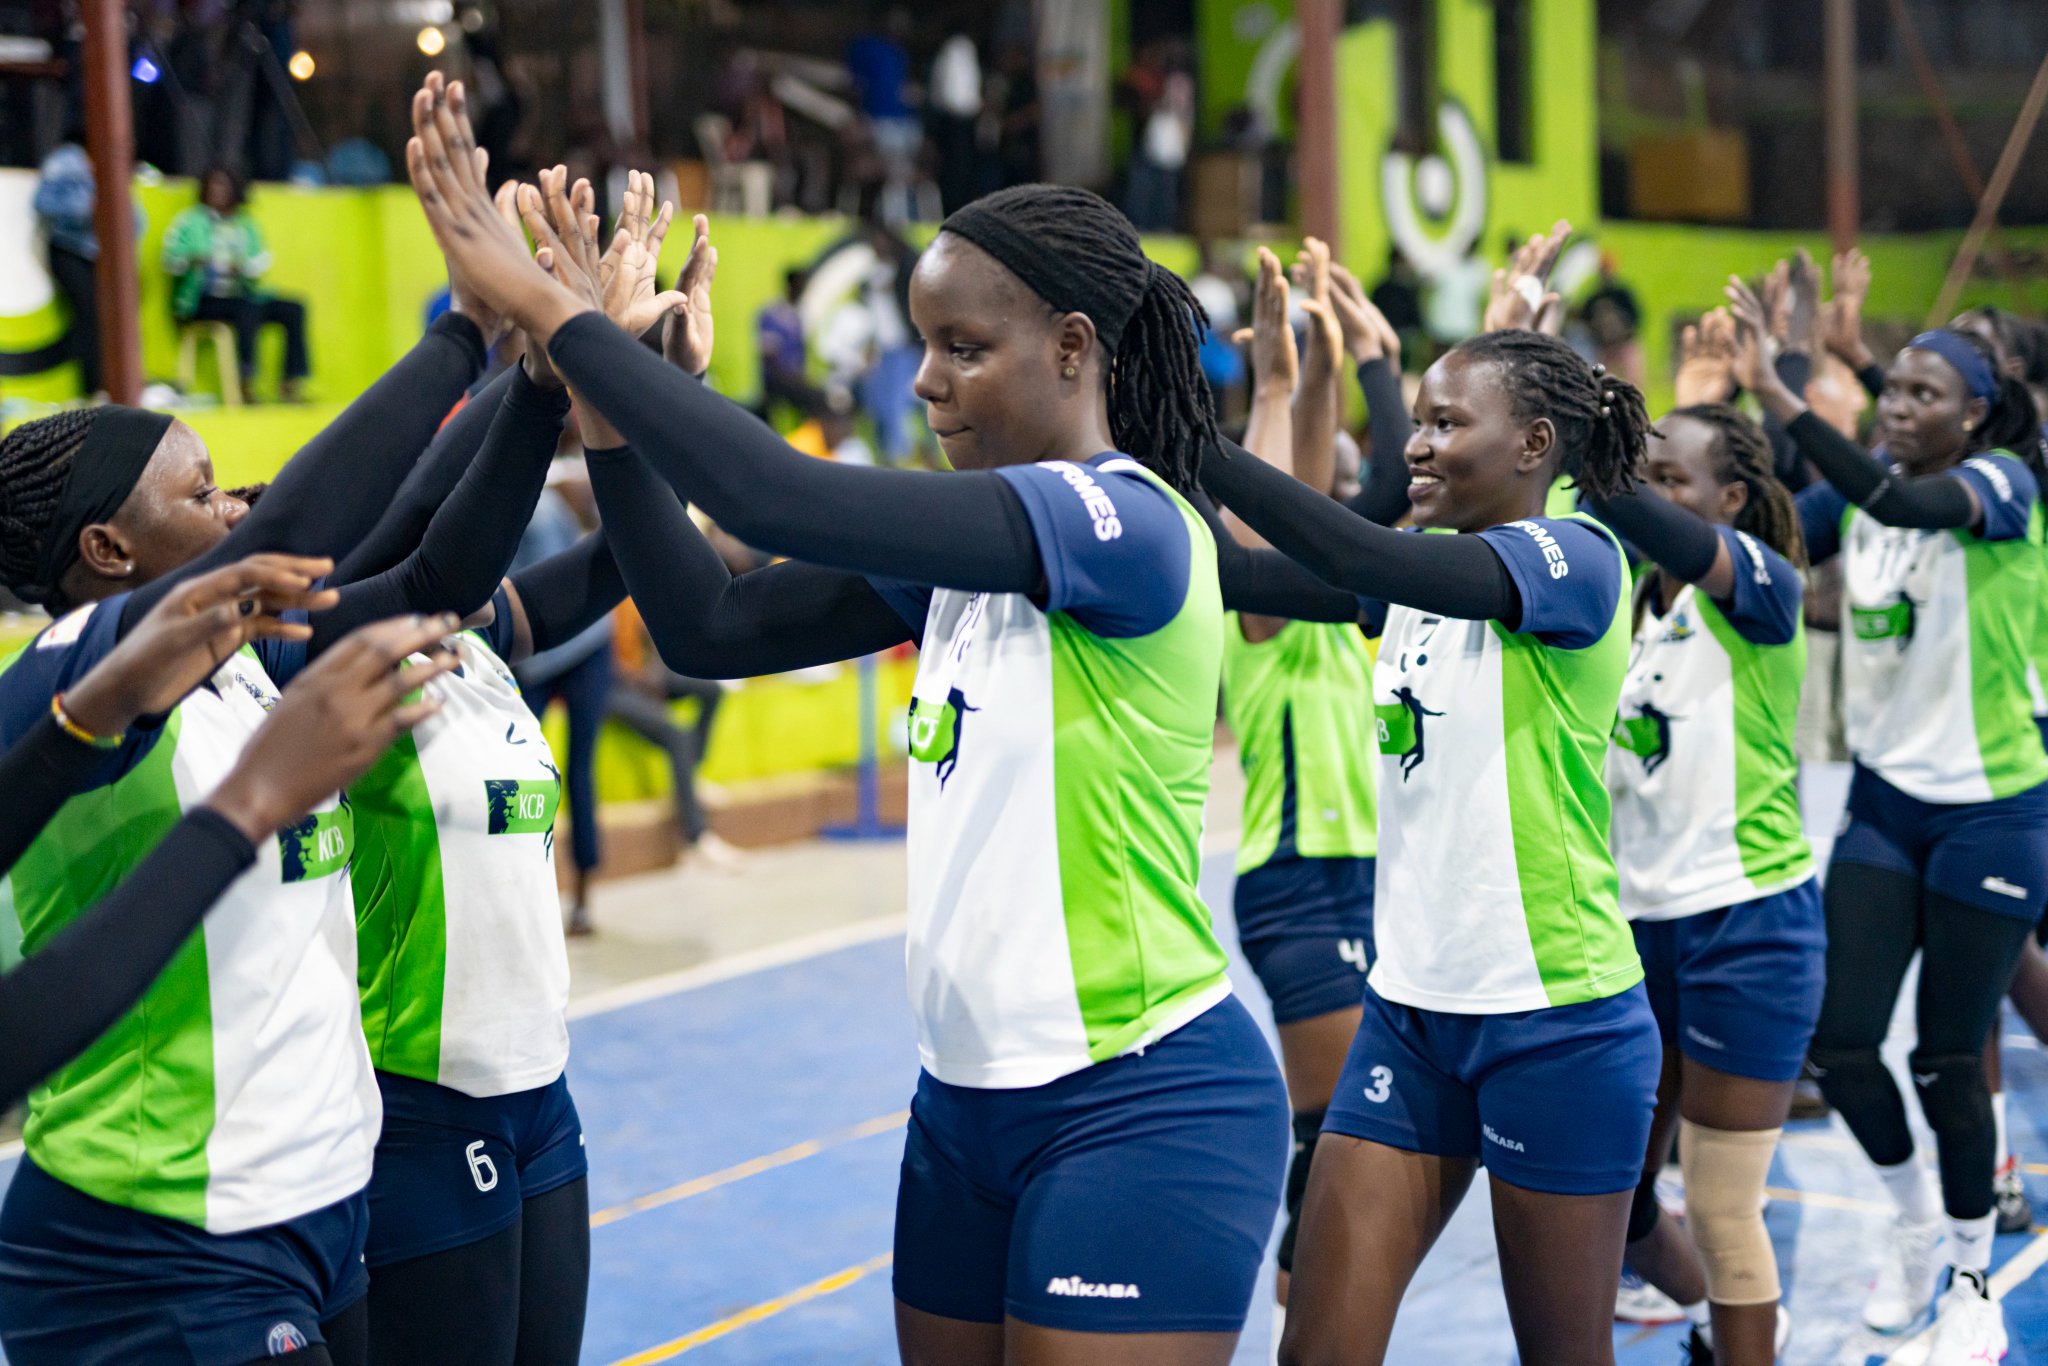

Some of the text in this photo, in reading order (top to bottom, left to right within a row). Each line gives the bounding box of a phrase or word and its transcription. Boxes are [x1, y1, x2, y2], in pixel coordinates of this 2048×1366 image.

[518, 793, 545, 820] KCB
[318, 825, 344, 863] KCB
[1337, 937, 1369, 973] 4
[1363, 1065, 1394, 1103] 3
[465, 1139, 498, 1192] 6
